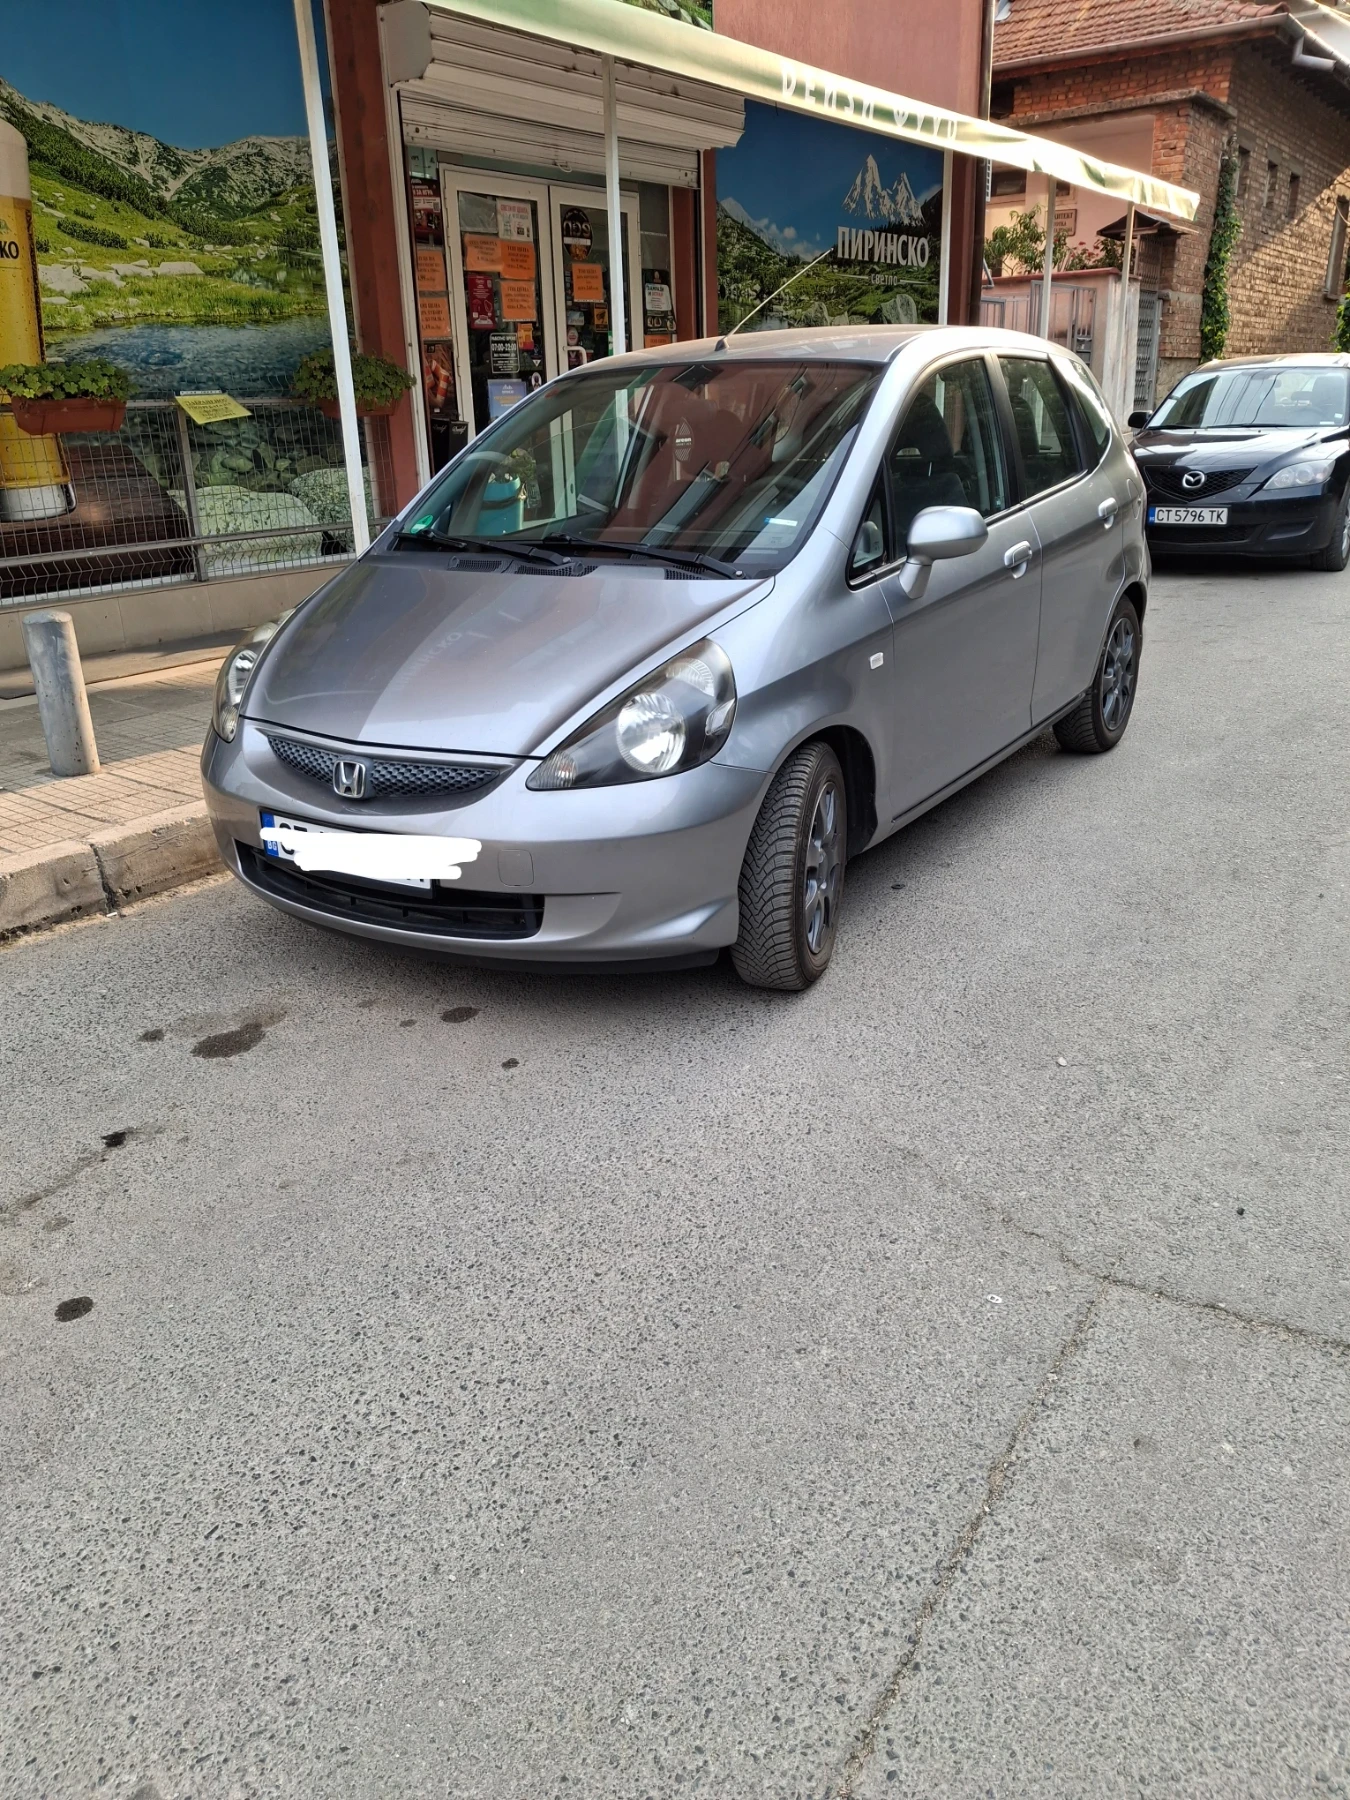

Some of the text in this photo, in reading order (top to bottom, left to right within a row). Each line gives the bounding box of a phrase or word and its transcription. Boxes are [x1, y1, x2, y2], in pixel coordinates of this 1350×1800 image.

[837, 226, 929, 268] ПИРИНСКО
[1156, 509, 1225, 523] CT 5796 TK
[266, 840, 278, 851] BG
